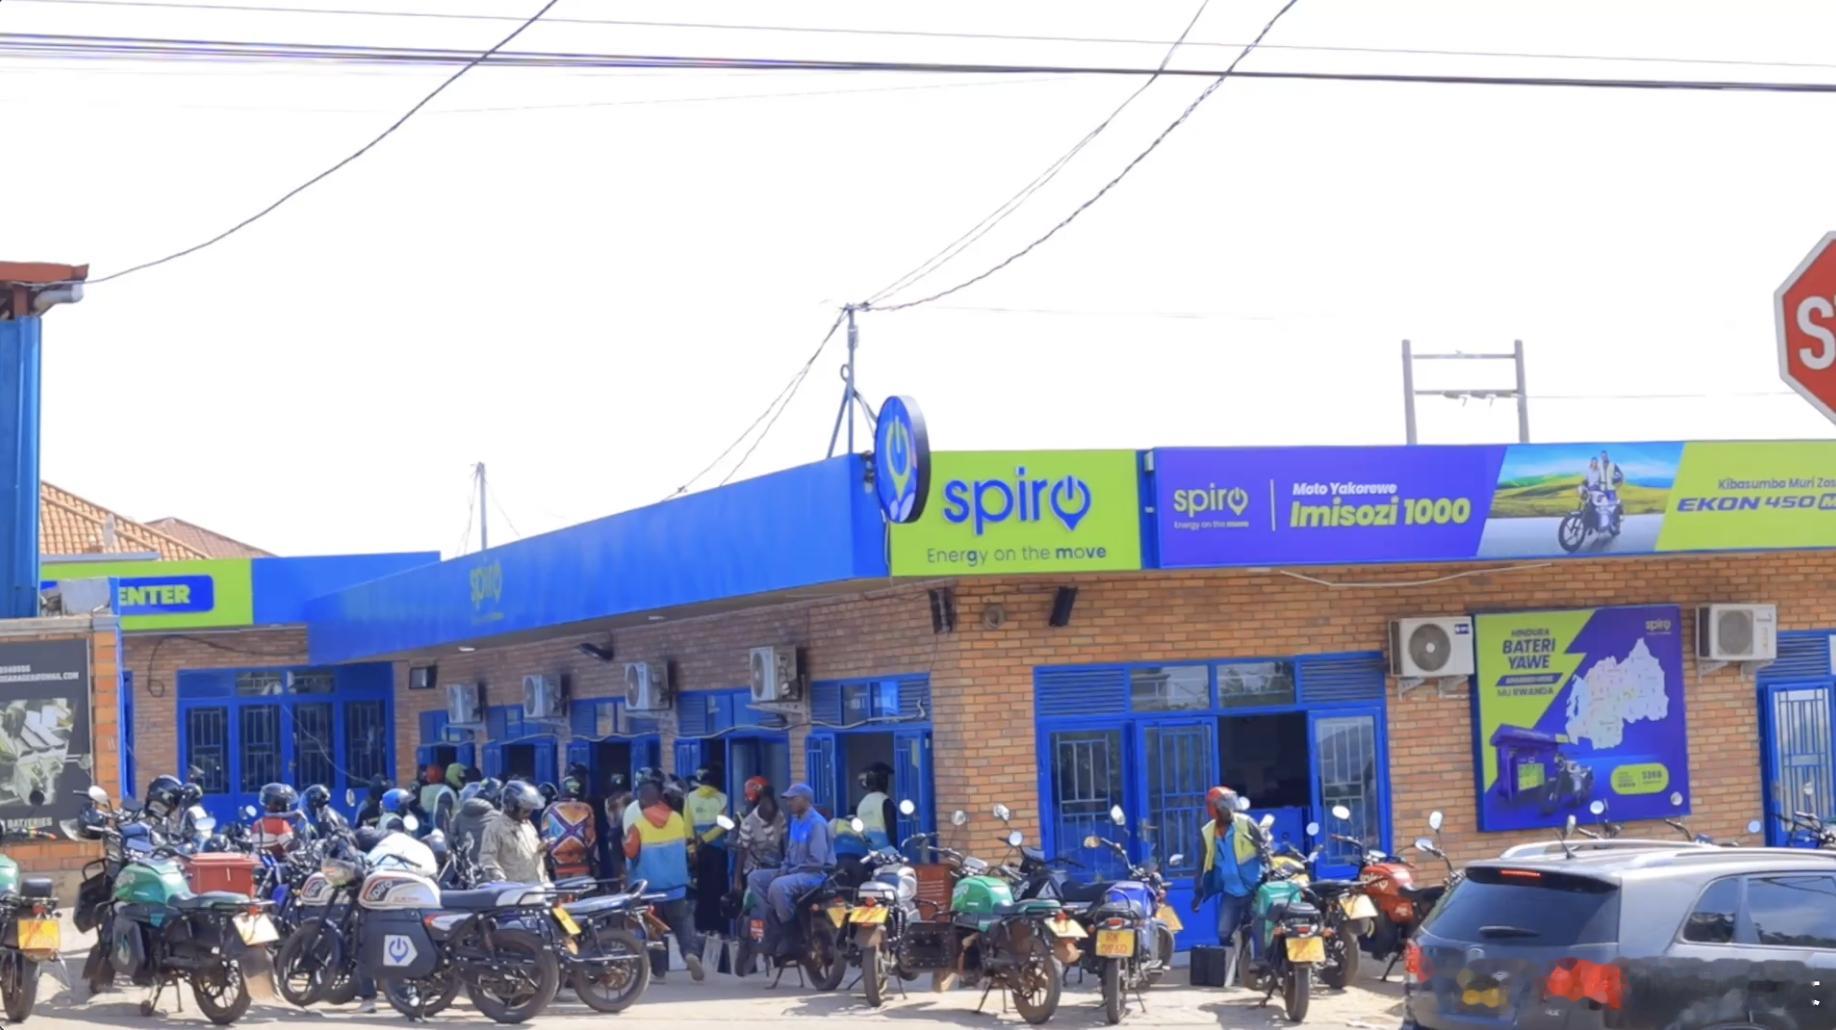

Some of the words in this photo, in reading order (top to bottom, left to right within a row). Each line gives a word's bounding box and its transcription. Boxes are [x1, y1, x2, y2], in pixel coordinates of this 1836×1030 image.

[1797, 294, 1836, 371] S
[1174, 482, 1249, 517] spiro
[1292, 483, 1328, 496] Moto
[1330, 482, 1397, 495] Yakorewe
[943, 466, 1092, 536] spiro
[1290, 496, 1399, 528] Imisozi
[1404, 497, 1471, 525] 1000
[1676, 496, 1761, 512] EKON
[1764, 495, 1816, 509] 450
[927, 548, 988, 567] Energy
[993, 549, 1017, 561] on
[1022, 545, 1051, 560] the
[1055, 545, 1107, 560] move
[1502, 637, 1556, 655] BATERI
[1508, 654, 1551, 671] YAWE
